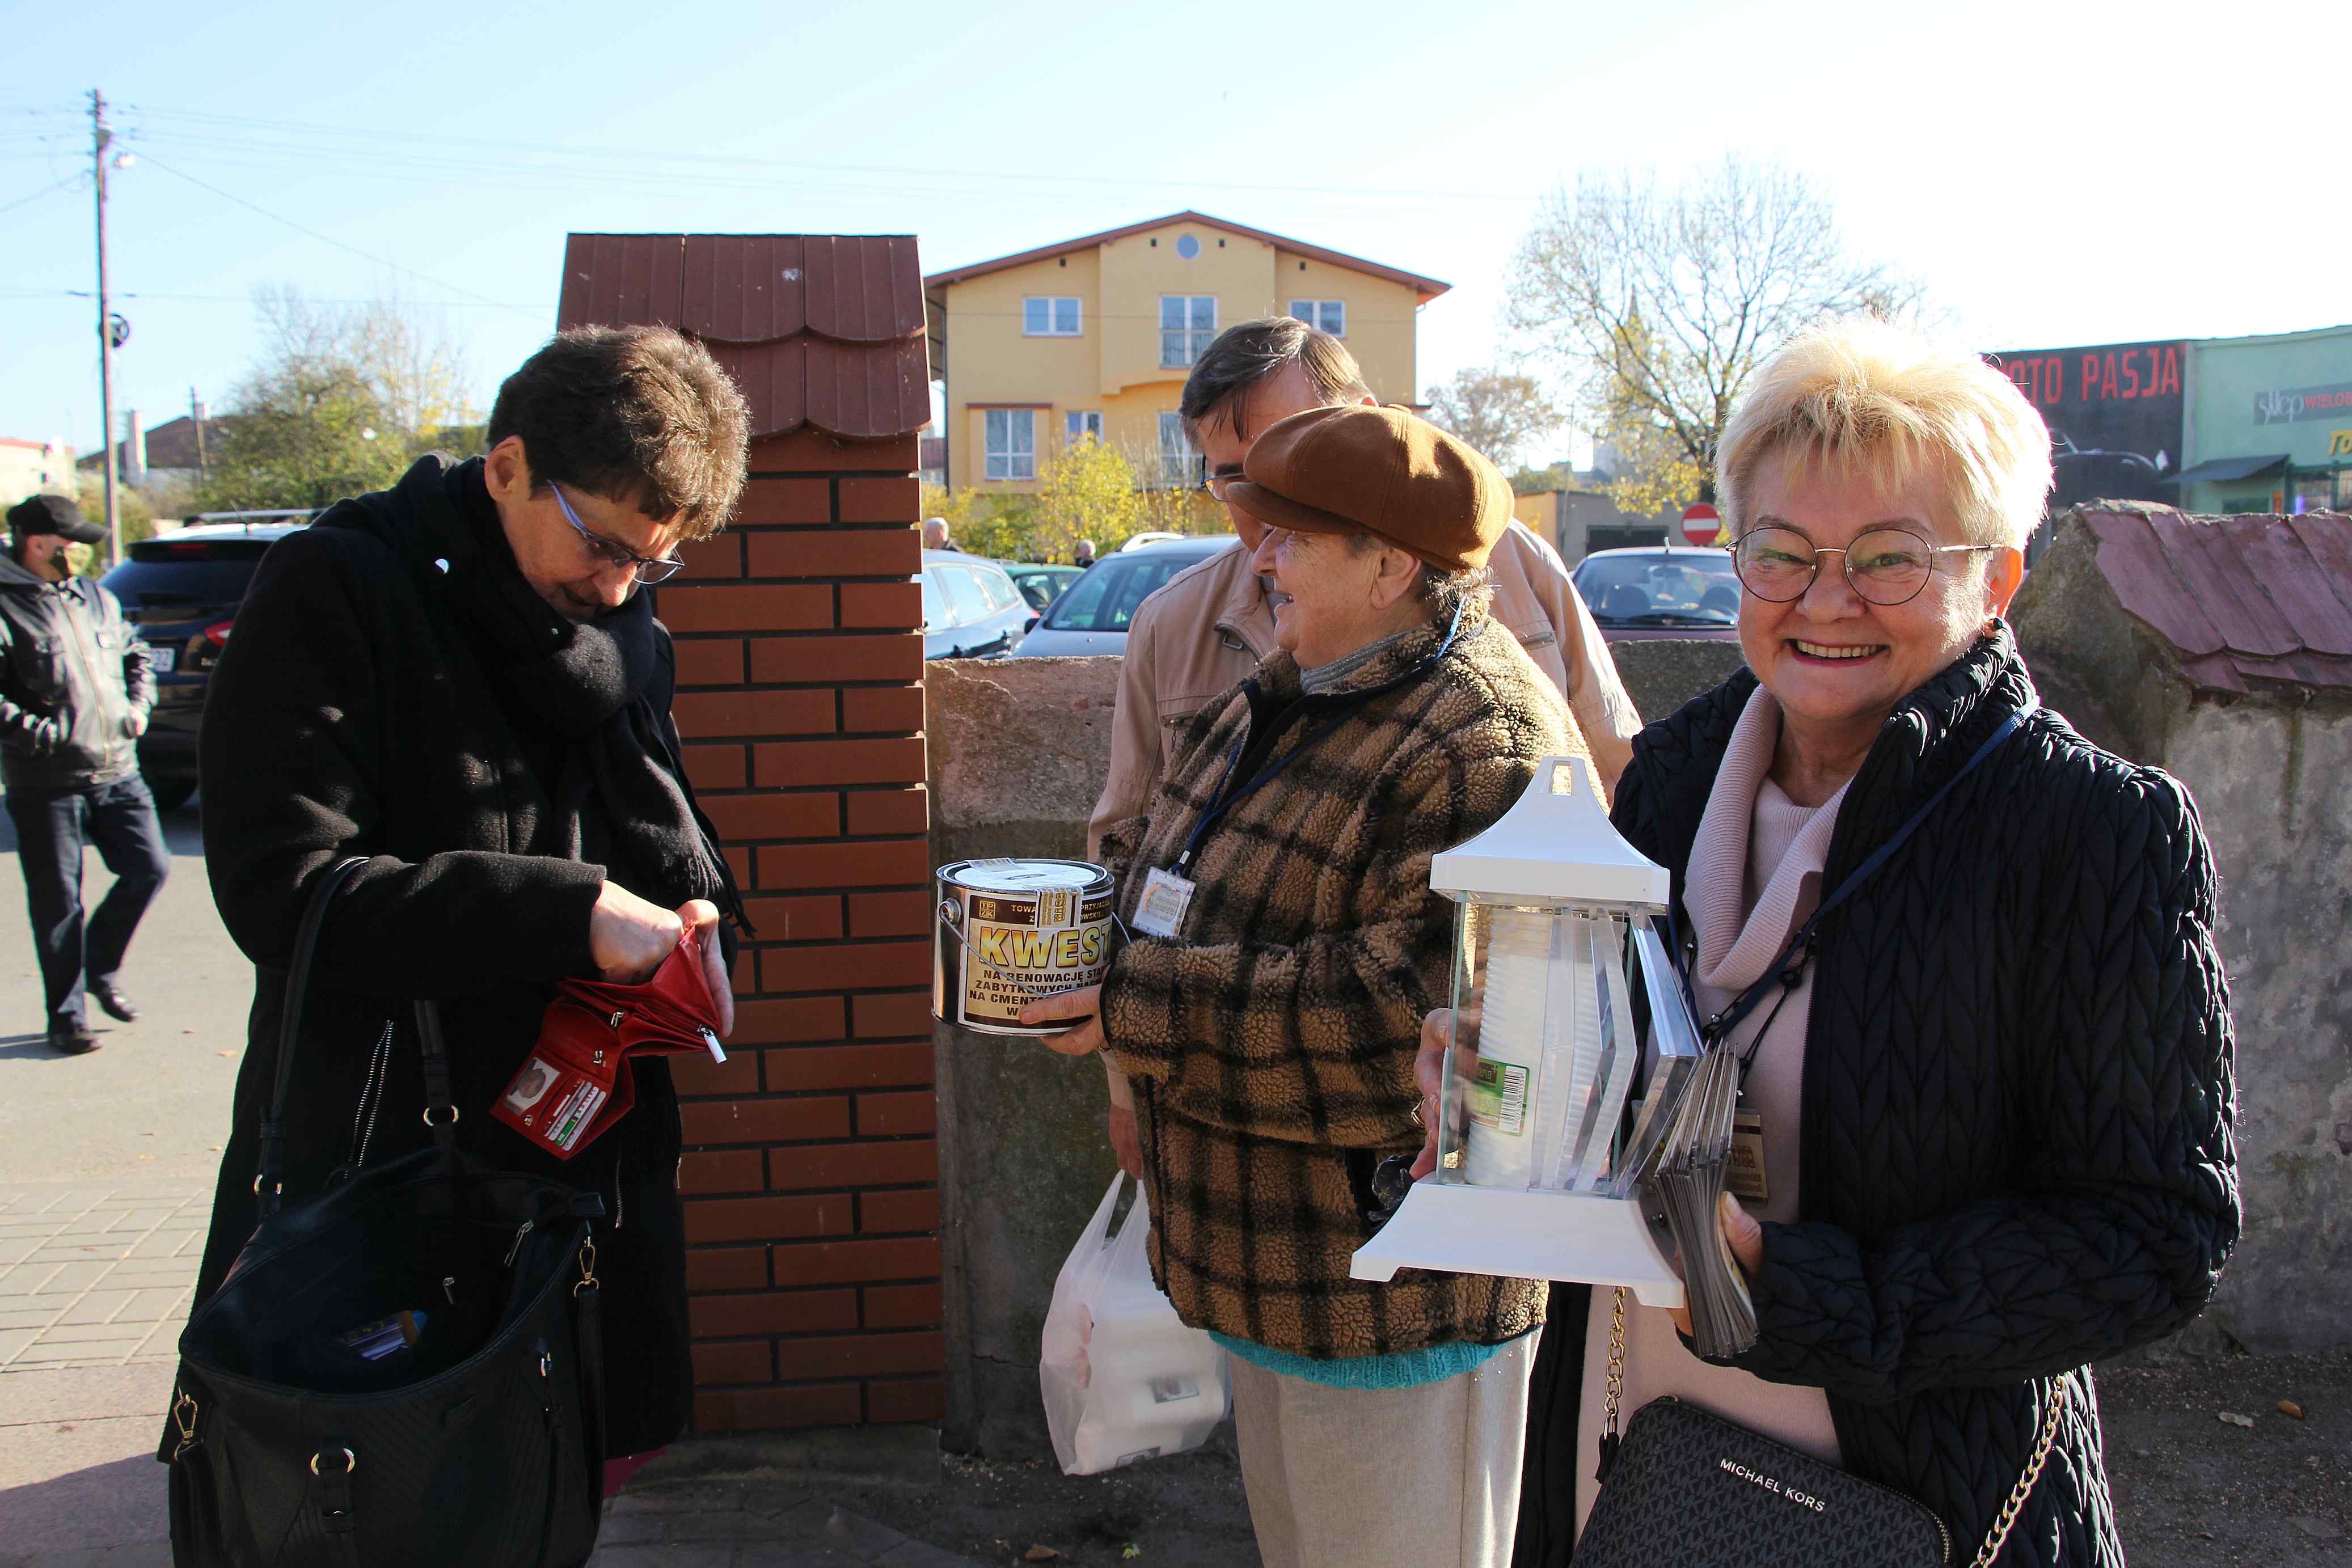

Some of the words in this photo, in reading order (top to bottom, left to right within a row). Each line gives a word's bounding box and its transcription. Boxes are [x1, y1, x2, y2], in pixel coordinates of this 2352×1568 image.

[2001, 357, 2062, 404] OTO
[1054, 890, 1067, 923] ESTA
[983, 970, 1000, 980] NA
[1006, 971, 1083, 983] RENOWACJĘ
[969, 990, 985, 1001] NA
[1720, 1458, 1780, 1493] MICHAEL
[1785, 1487, 1826, 1512] KORS
